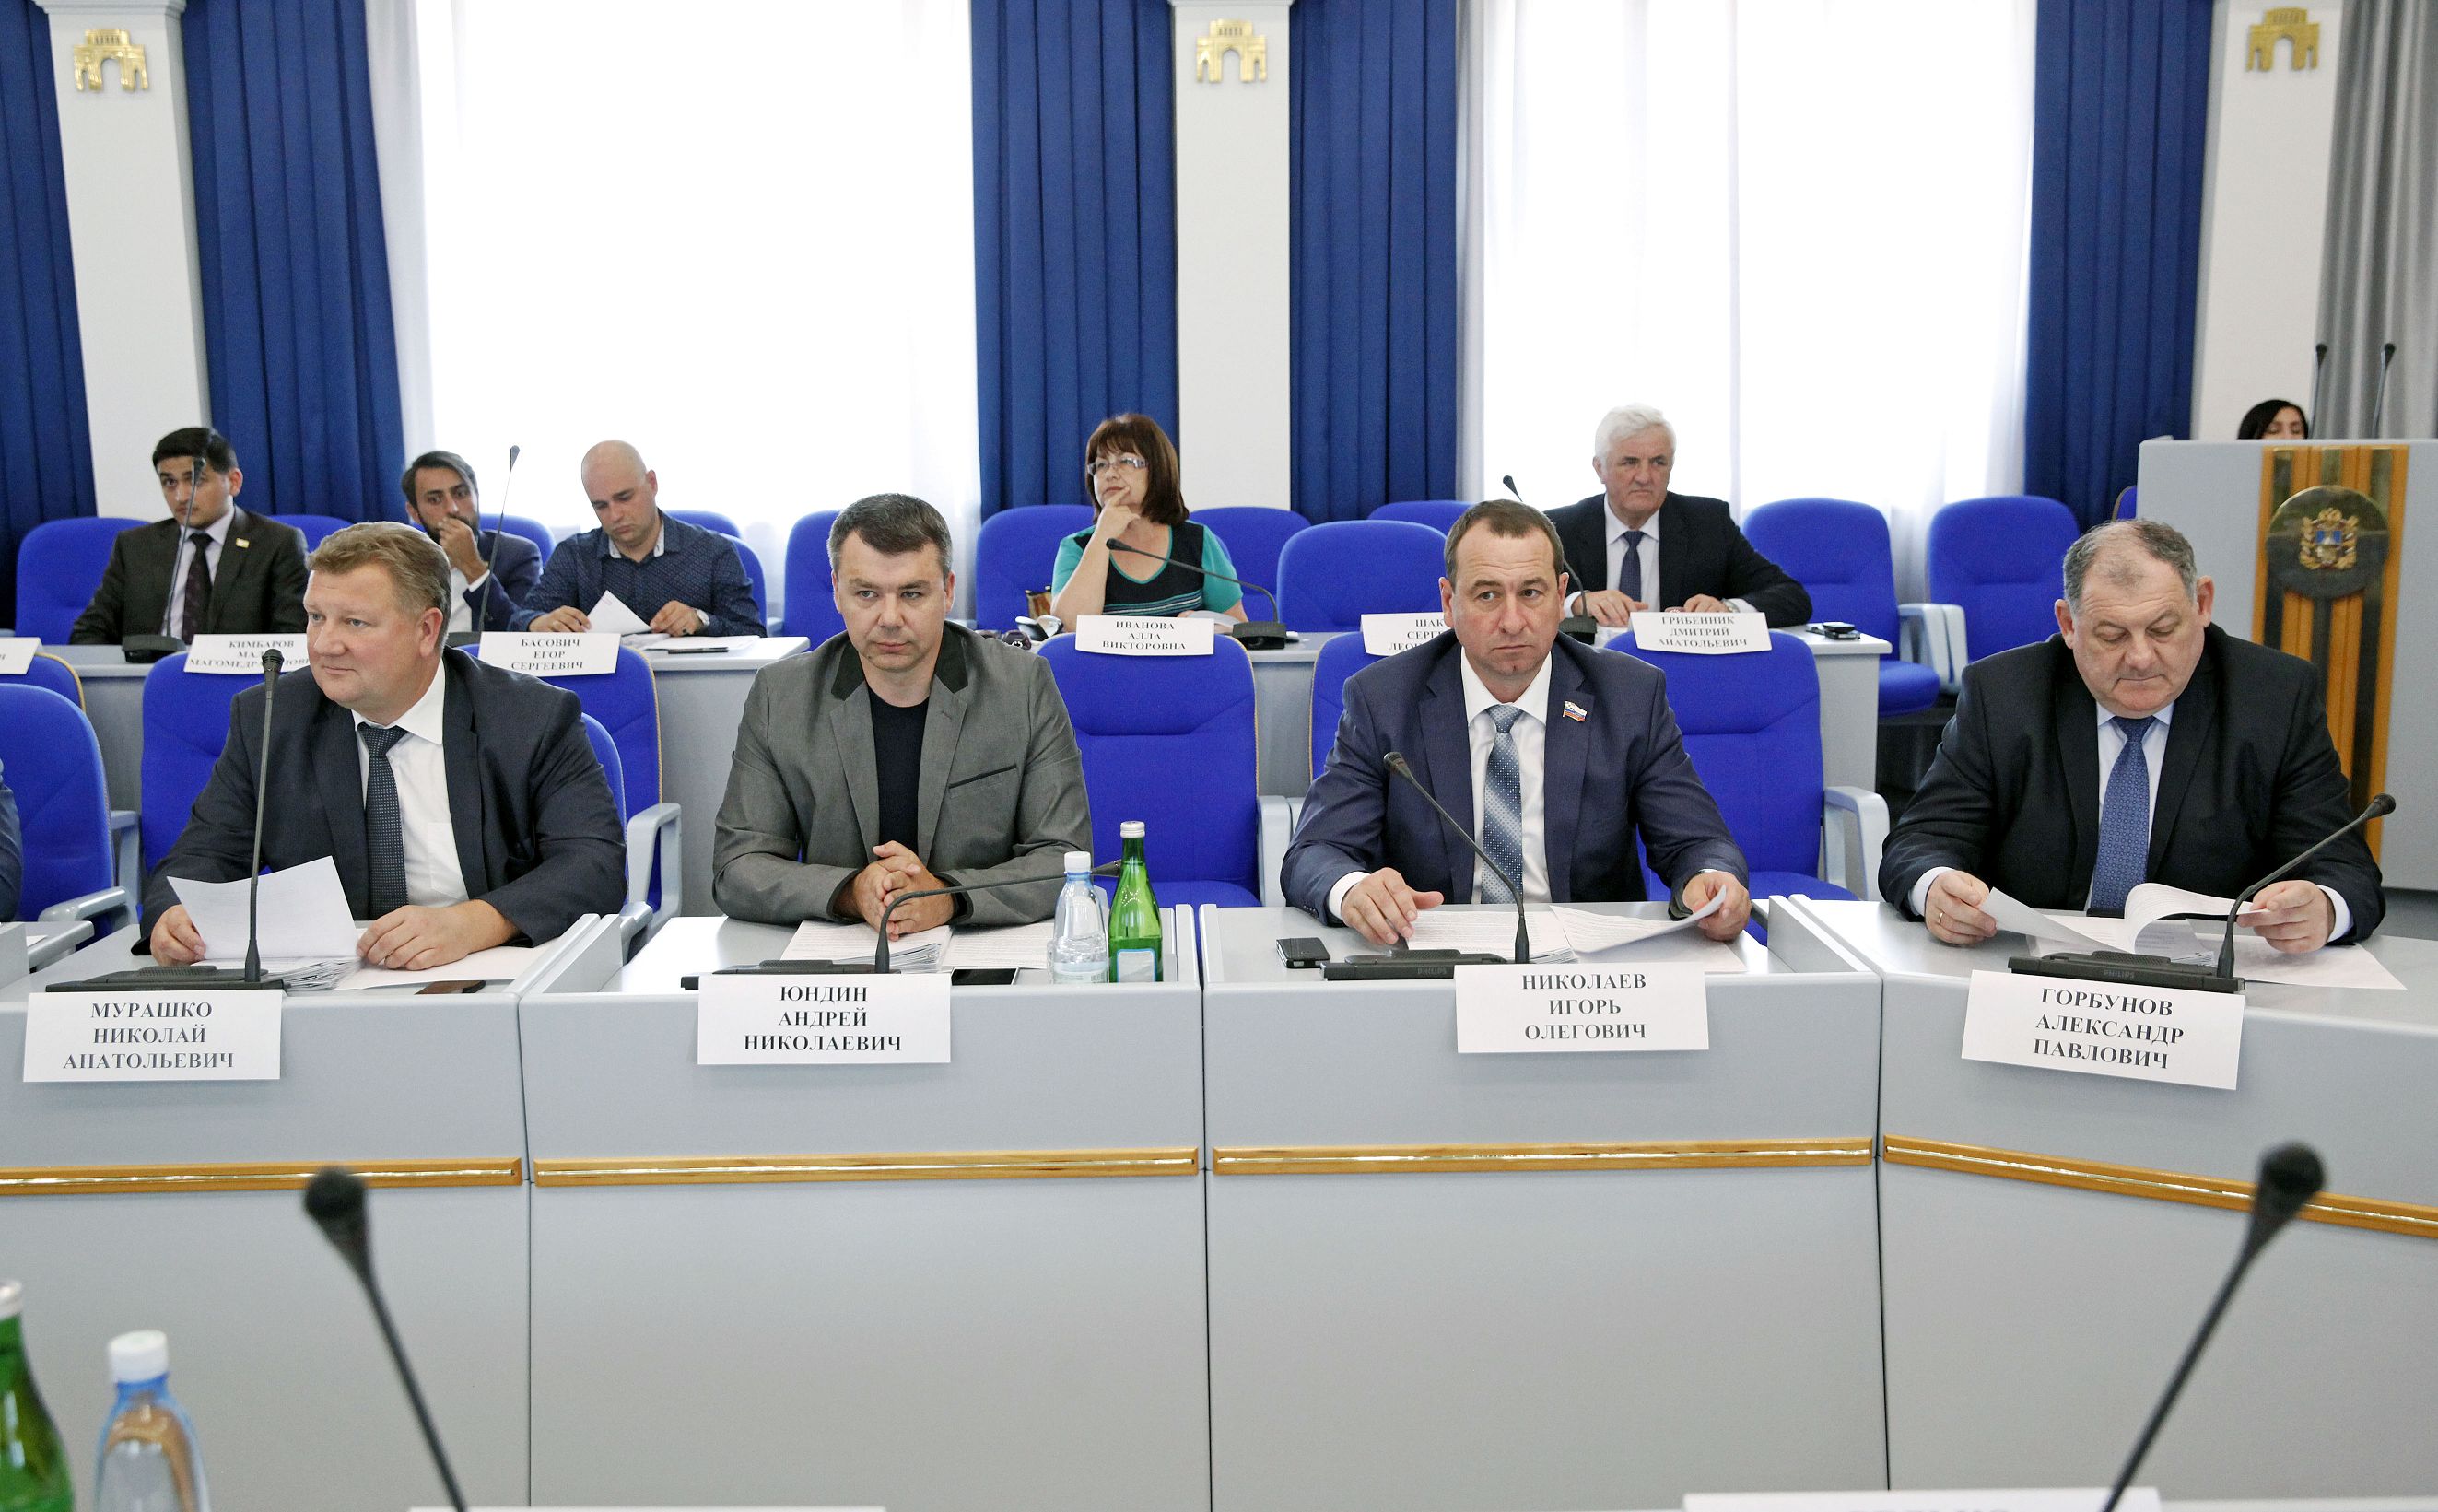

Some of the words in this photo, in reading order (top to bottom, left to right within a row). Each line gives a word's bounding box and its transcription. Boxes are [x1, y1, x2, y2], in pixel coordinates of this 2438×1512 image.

[1116, 621, 1175, 630] ИВАНОВА
[1415, 618, 1445, 627] ШАК
[1661, 616, 1734, 625] ГРИБЕННИК
[1128, 632, 1161, 640] АЛЛА
[1670, 627, 1729, 637] ДМИТРИЙ
[229, 640, 294, 649] КИМБАРОВ
[521, 639, 580, 647] БАСОВИЧ
[1102, 640, 1186, 650] ВИКТОРОВНА
[1659, 639, 1747, 648] АНАТОЛЬЕВИЧ
[533, 651, 566, 659] ЕГОР
[510, 662, 583, 671] СЕРГЕЕВИЧ
[1522, 973, 1647, 990] НИКОЛАЕВ
[780, 986, 867, 1003] ЮНДИН
[2040, 987, 2174, 1017] ГОРБУНОВ
[91, 1002, 213, 1018] МУРАШКО
[1550, 999, 1622, 1014] ИГОРЬ
[779, 1007, 867, 1028] АНДРЕЙ
[94, 1023, 205, 1044] НИКОЛАЙ
[1524, 1024, 1646, 1040] ОЛЕГОВИЧ
[2034, 1013, 2185, 1048] АЛЕКСАНДР
[744, 1035, 901, 1051] НИКОЛАЕВИЧ
[63, 1052, 233, 1070] АНАТОЛЬЕВИЧ
[2033, 1037, 2170, 1070] ПАВЛОВИЧ
